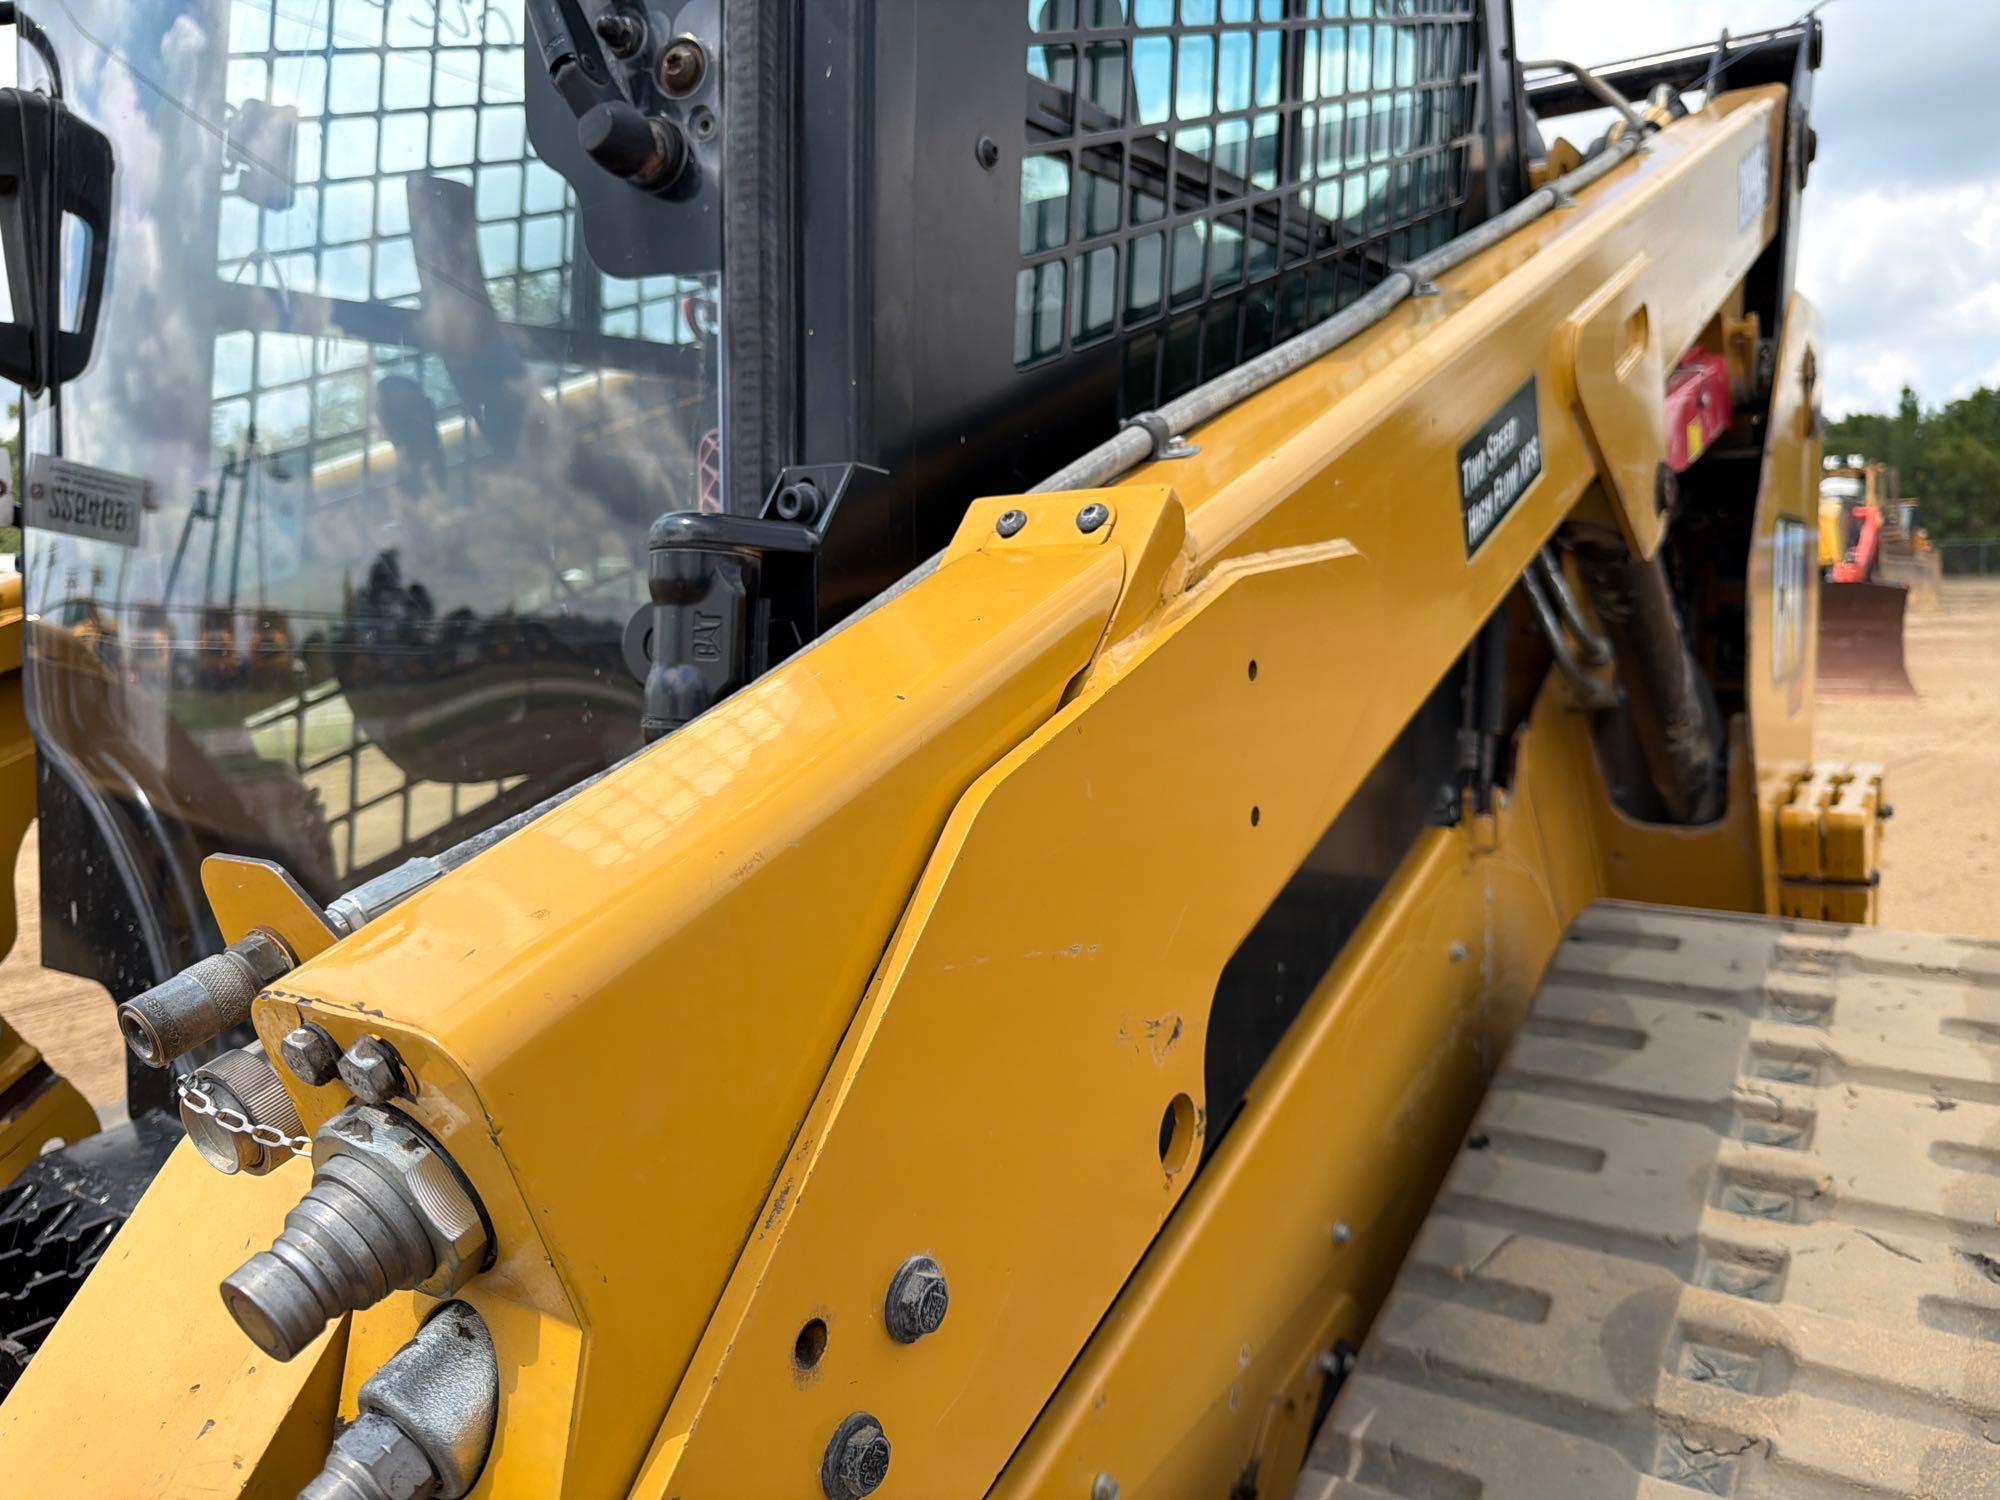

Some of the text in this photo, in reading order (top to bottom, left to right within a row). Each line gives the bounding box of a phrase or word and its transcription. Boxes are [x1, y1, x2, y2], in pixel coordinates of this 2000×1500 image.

[1493, 462, 1520, 515] FLOW
[1520, 434, 1539, 480] XPS
[693, 610, 722, 662] CAT
